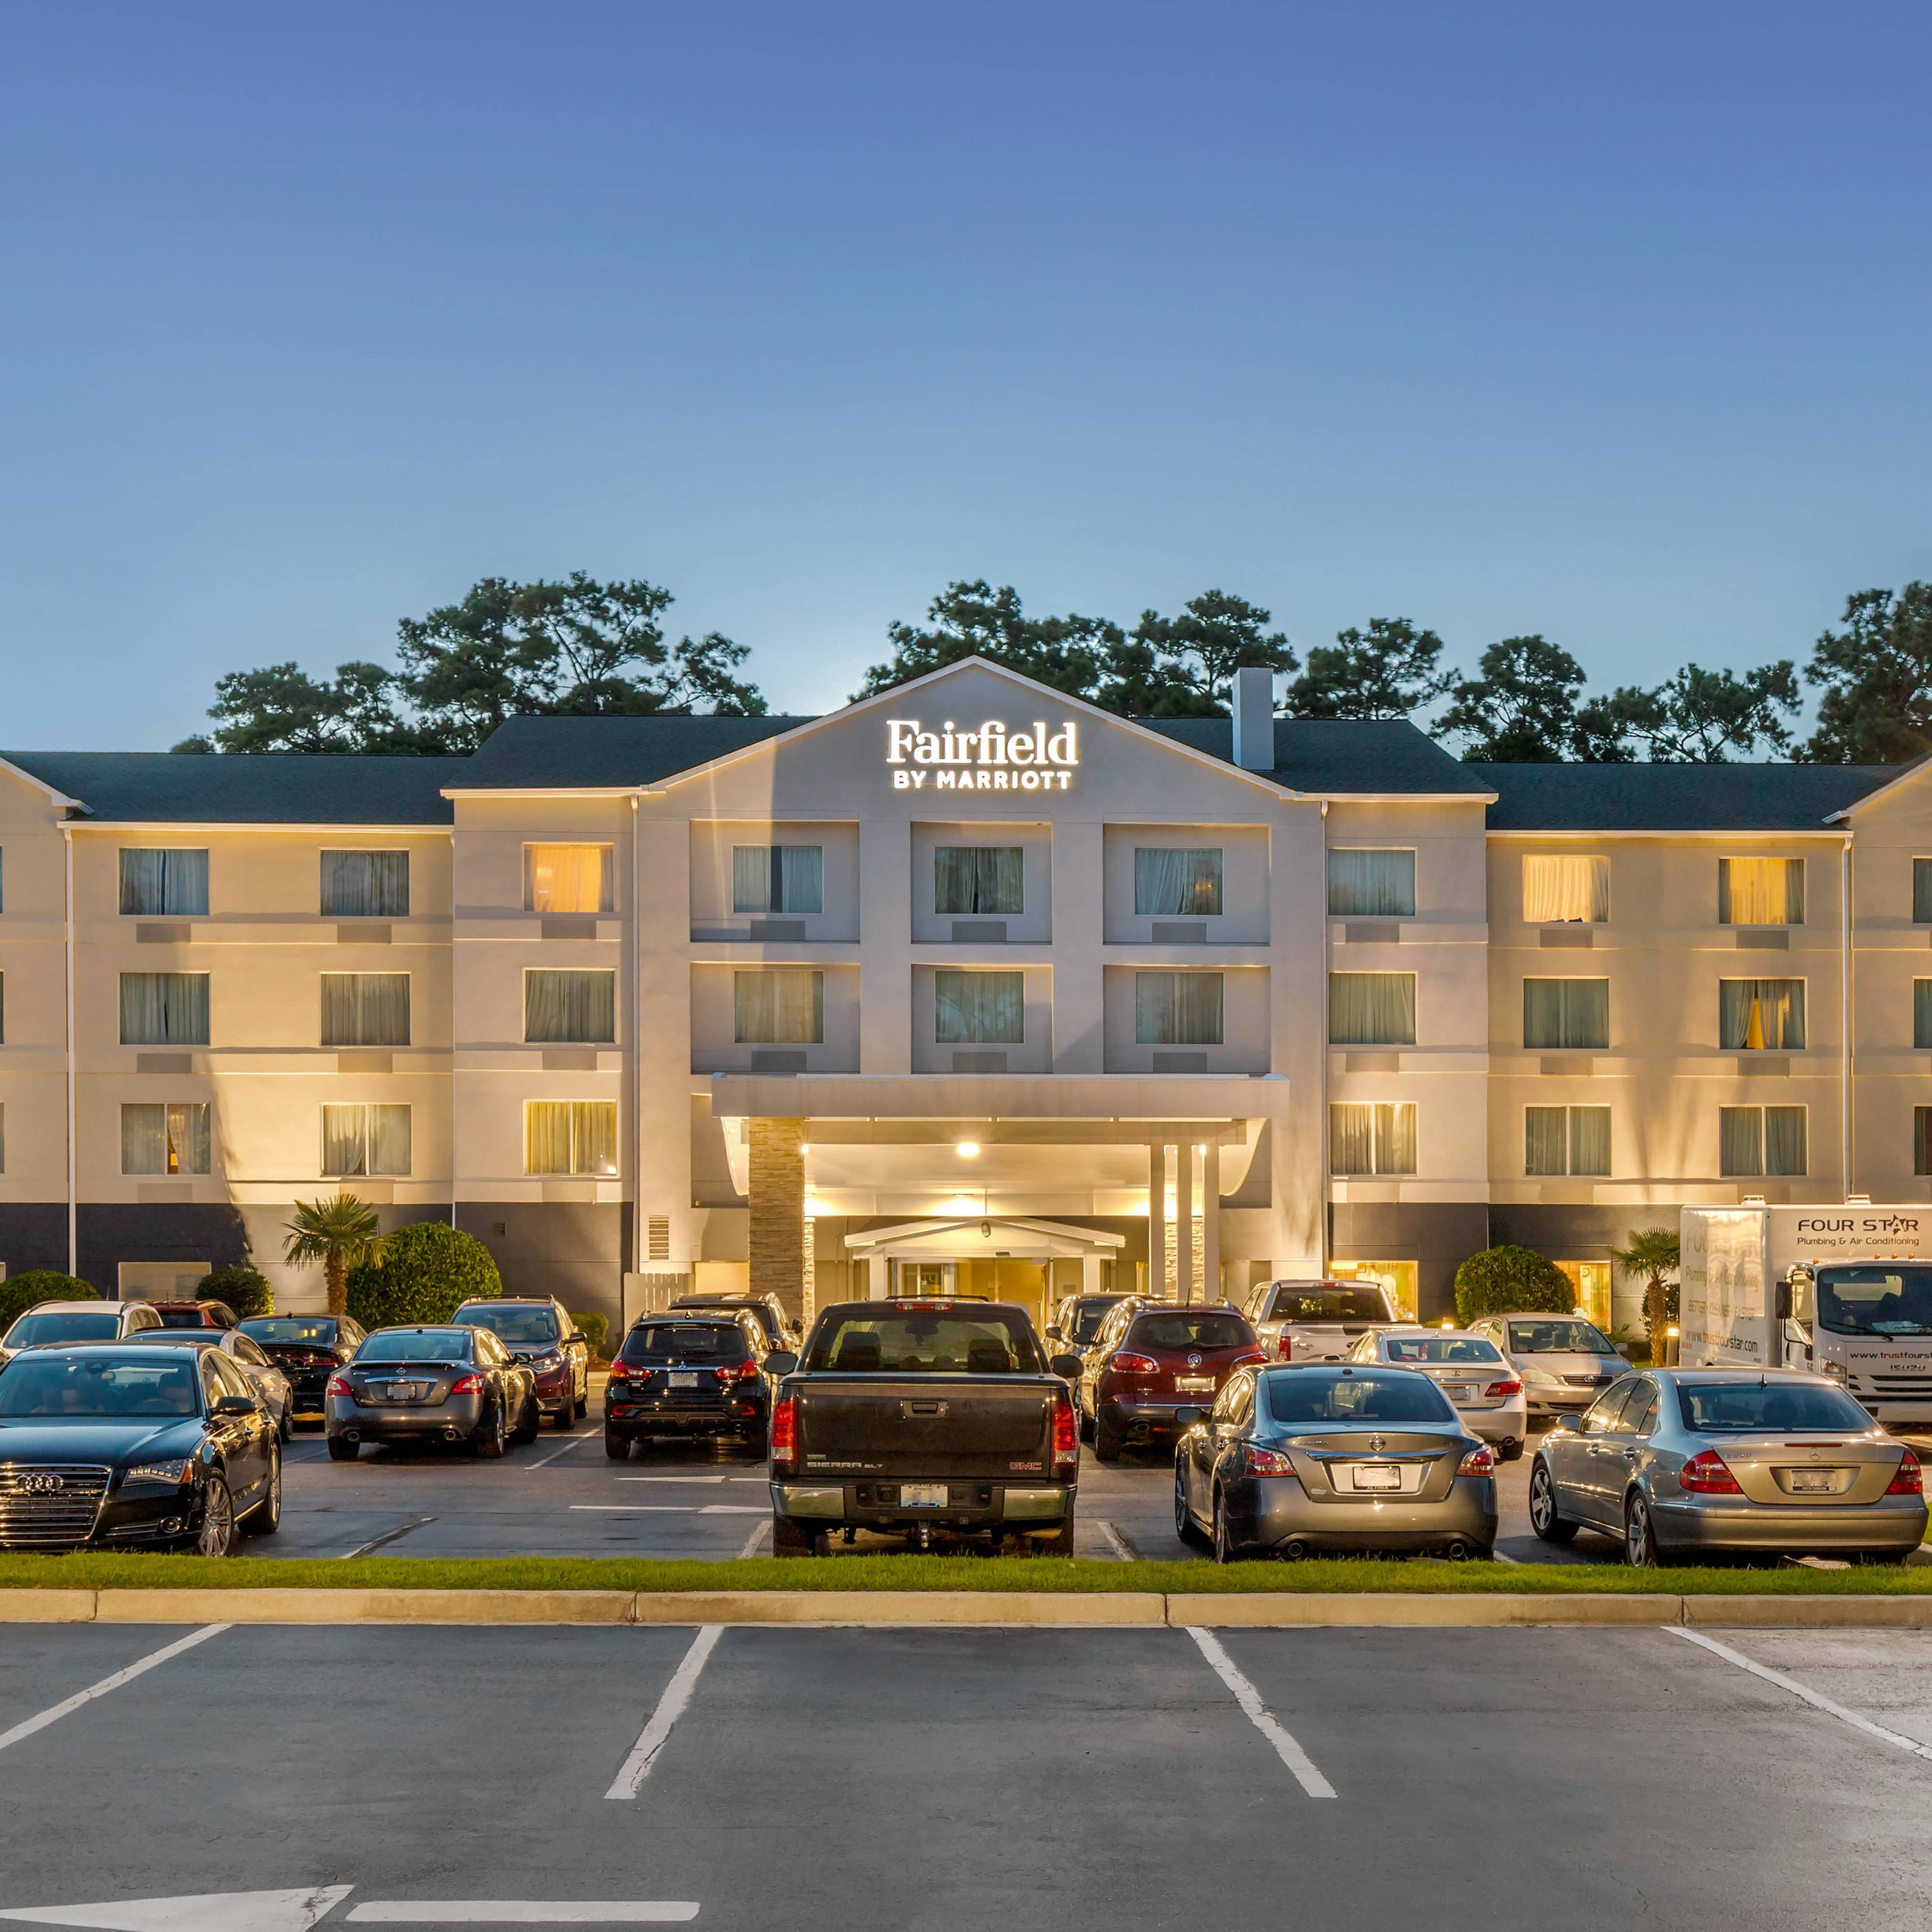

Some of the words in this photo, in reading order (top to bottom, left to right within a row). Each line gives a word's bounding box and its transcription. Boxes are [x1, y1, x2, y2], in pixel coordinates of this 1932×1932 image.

[886, 720, 1079, 765] Fairfield
[893, 770, 926, 789] BY
[937, 770, 1072, 789] MARRIOTT
[1798, 1220, 1854, 1231] FOUR
[1863, 1217, 1919, 1233] STAR
[1797, 1237, 1836, 1246] Plumbing
[1866, 1237, 1919, 1246] Conditioning
[1686, 1265, 1707, 1286] Plumbing
[1688, 1300, 1706, 1314] BETTER
[1685, 1330, 1758, 1353] www.trustfourstar.com
[1009, 1462, 1042, 1470] GMC
